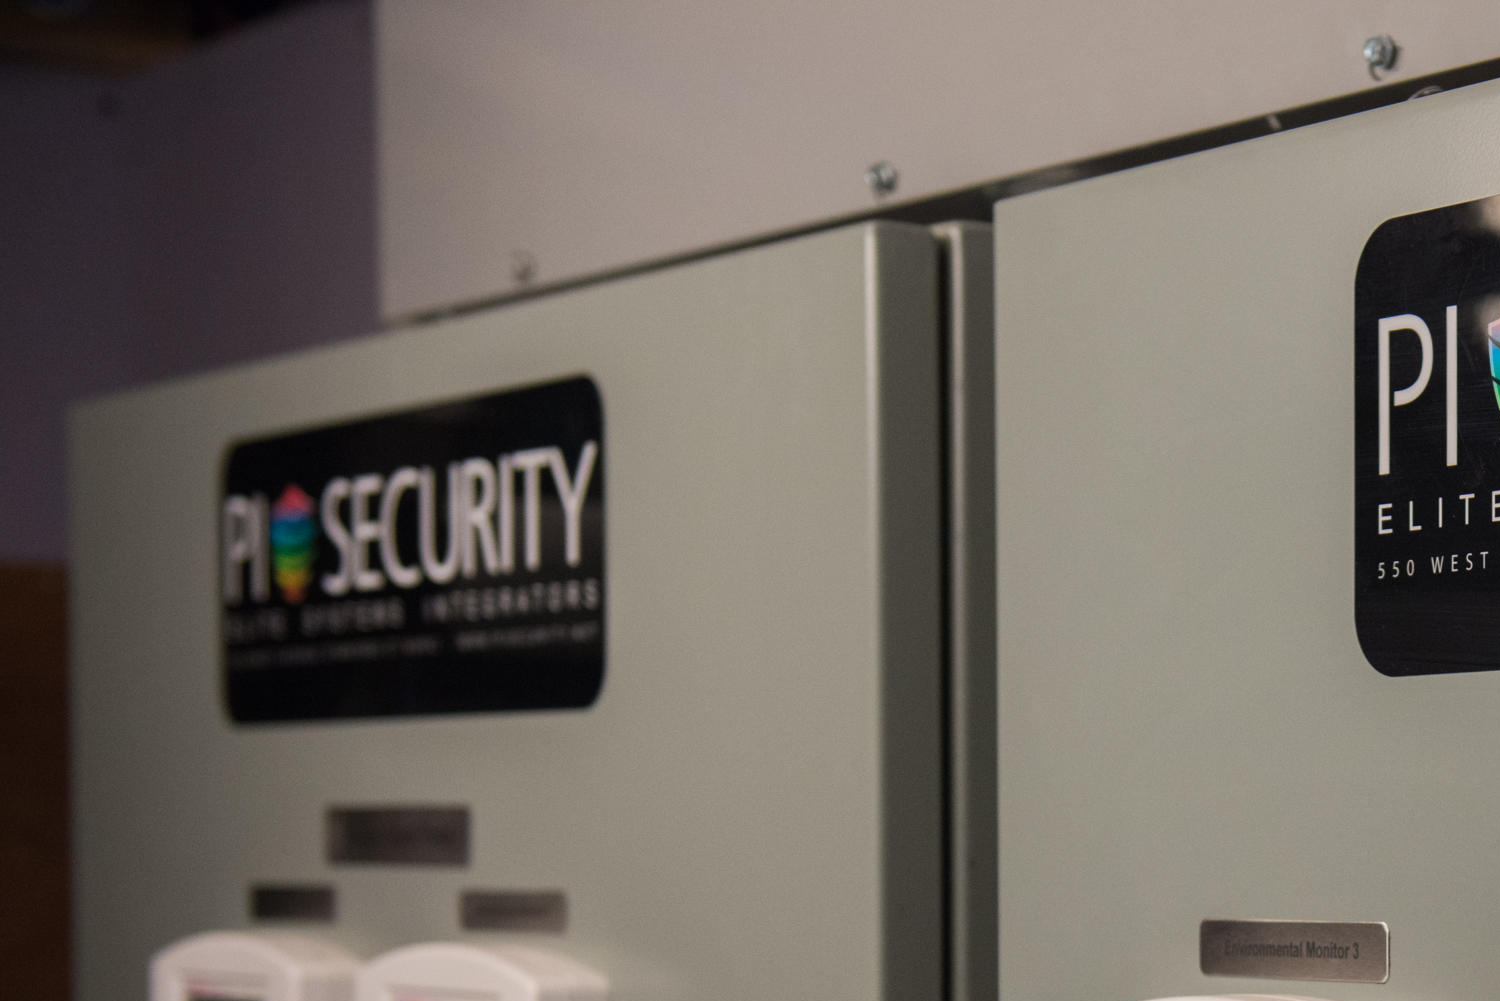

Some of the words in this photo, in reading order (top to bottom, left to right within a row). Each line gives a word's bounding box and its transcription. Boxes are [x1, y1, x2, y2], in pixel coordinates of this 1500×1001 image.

[1378, 304, 1457, 476] PI
[321, 440, 597, 596] SECURITY
[1378, 560, 1415, 579] 550
[1431, 551, 1488, 574] WEST
[1224, 940, 1302, 959] Environmental
[1306, 941, 1349, 960] Monitor
[1353, 942, 1360, 960] 3
